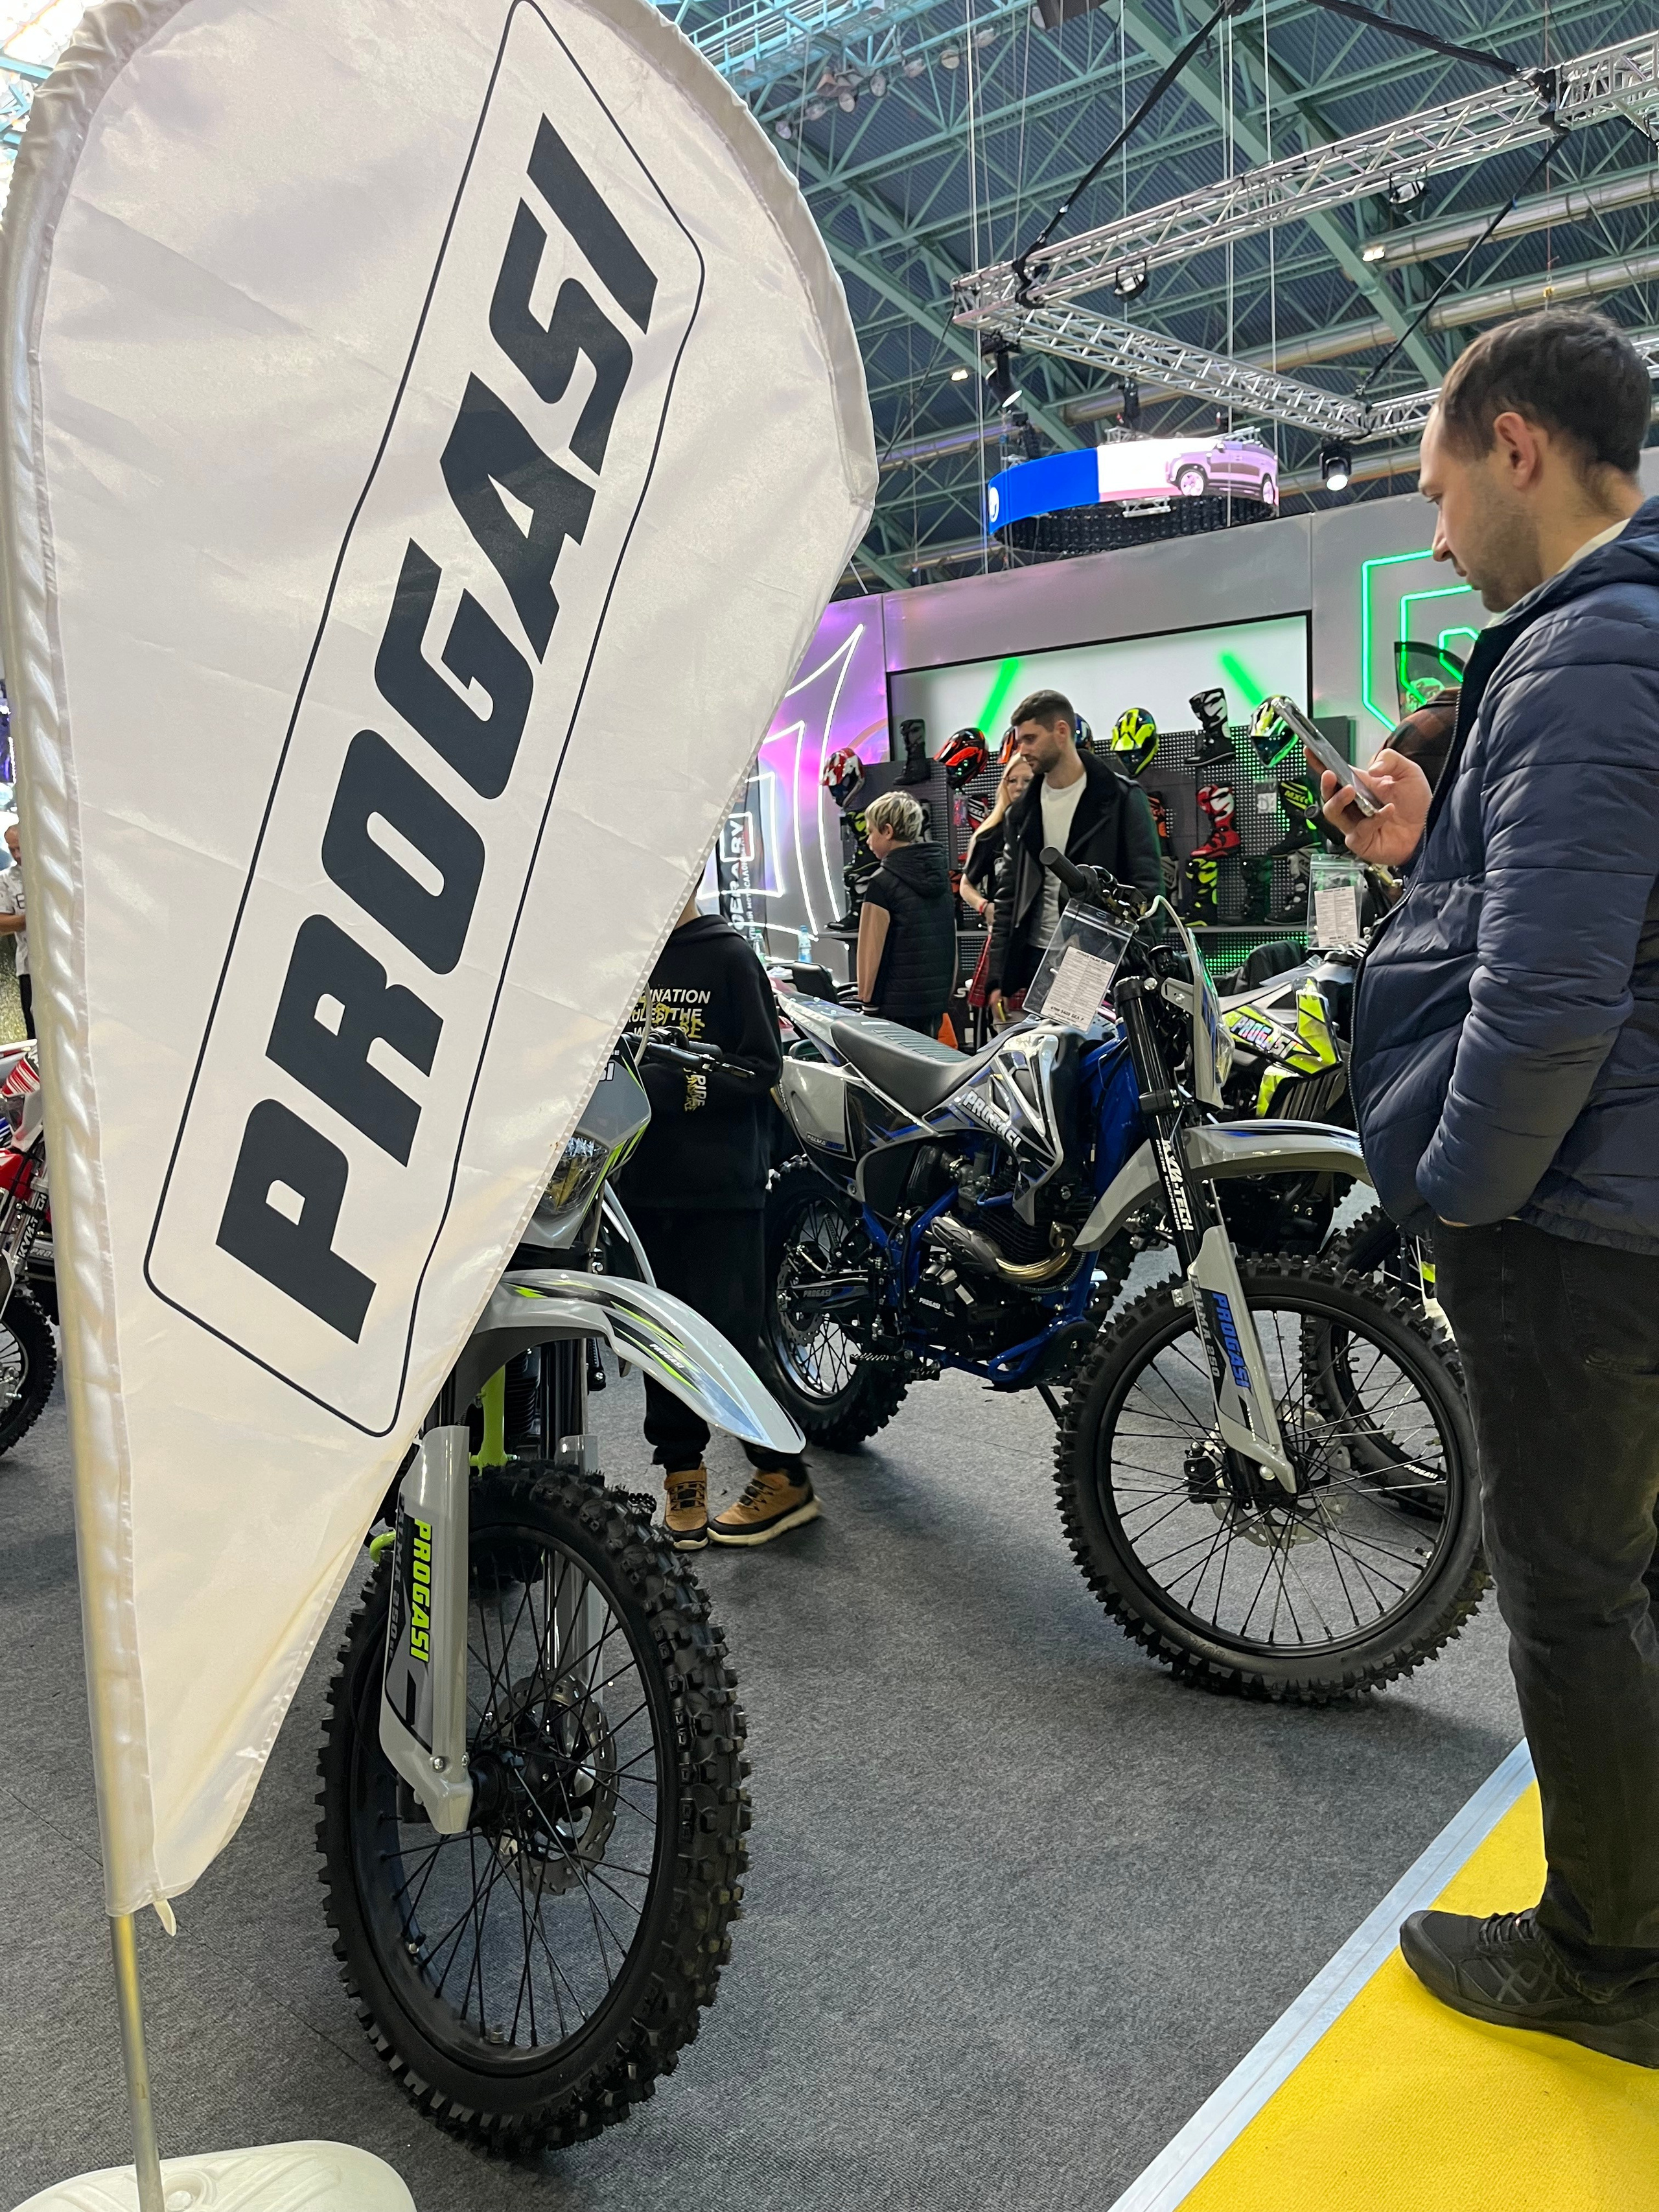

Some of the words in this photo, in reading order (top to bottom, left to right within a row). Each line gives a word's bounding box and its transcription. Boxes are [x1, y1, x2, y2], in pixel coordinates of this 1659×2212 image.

[217, 112, 658, 1343] PROGASI
[1206, 1344, 1220, 1378] 250
[1212, 1292, 1251, 1388] PROGASI
[410, 1518, 432, 1663] PROGASI
